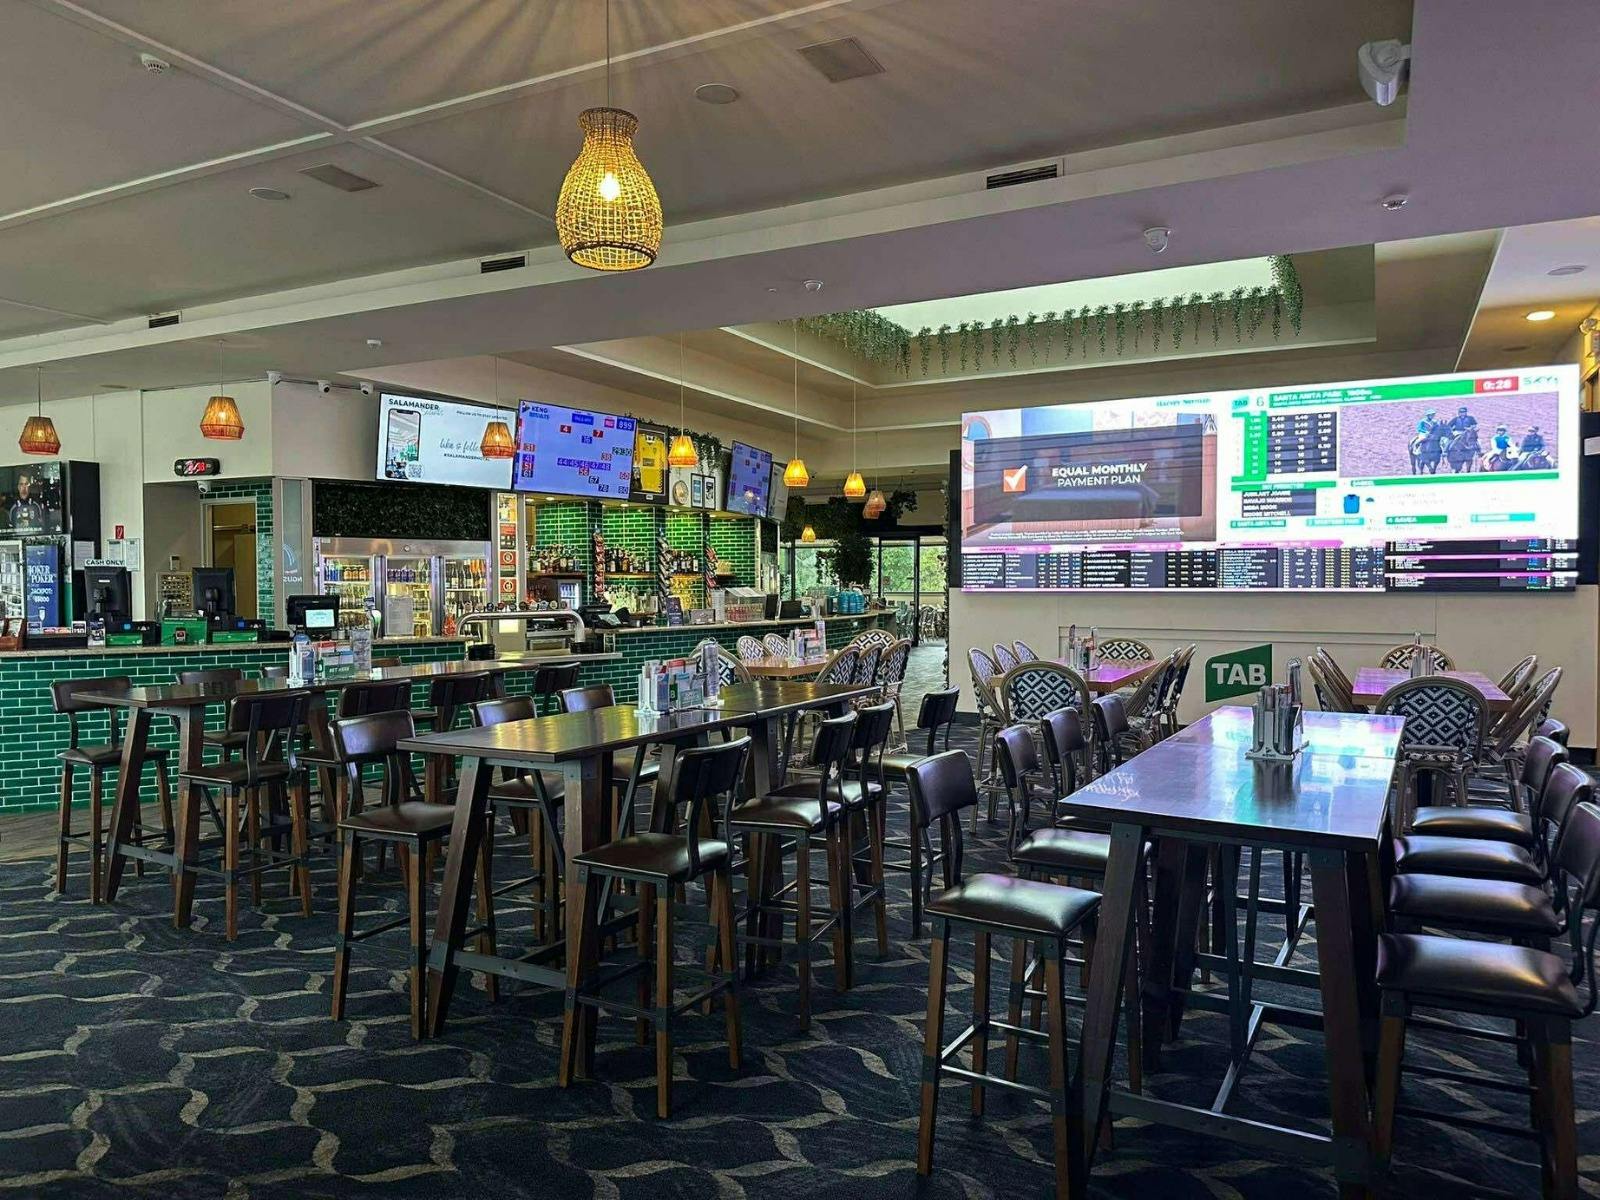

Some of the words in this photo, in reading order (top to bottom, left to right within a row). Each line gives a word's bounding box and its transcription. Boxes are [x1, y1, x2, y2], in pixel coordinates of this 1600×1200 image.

[388, 398, 440, 411] SALAMANDER
[462, 438, 481, 453] follo
[1052, 466, 1088, 478] EQUAL
[1091, 463, 1148, 476] MONTHLY
[1057, 475, 1108, 488] PAYMENT
[1111, 474, 1141, 485] PLAN
[29, 565, 50, 576] JOKER
[32, 574, 53, 583] POKER
[1211, 663, 1266, 686] TAB
